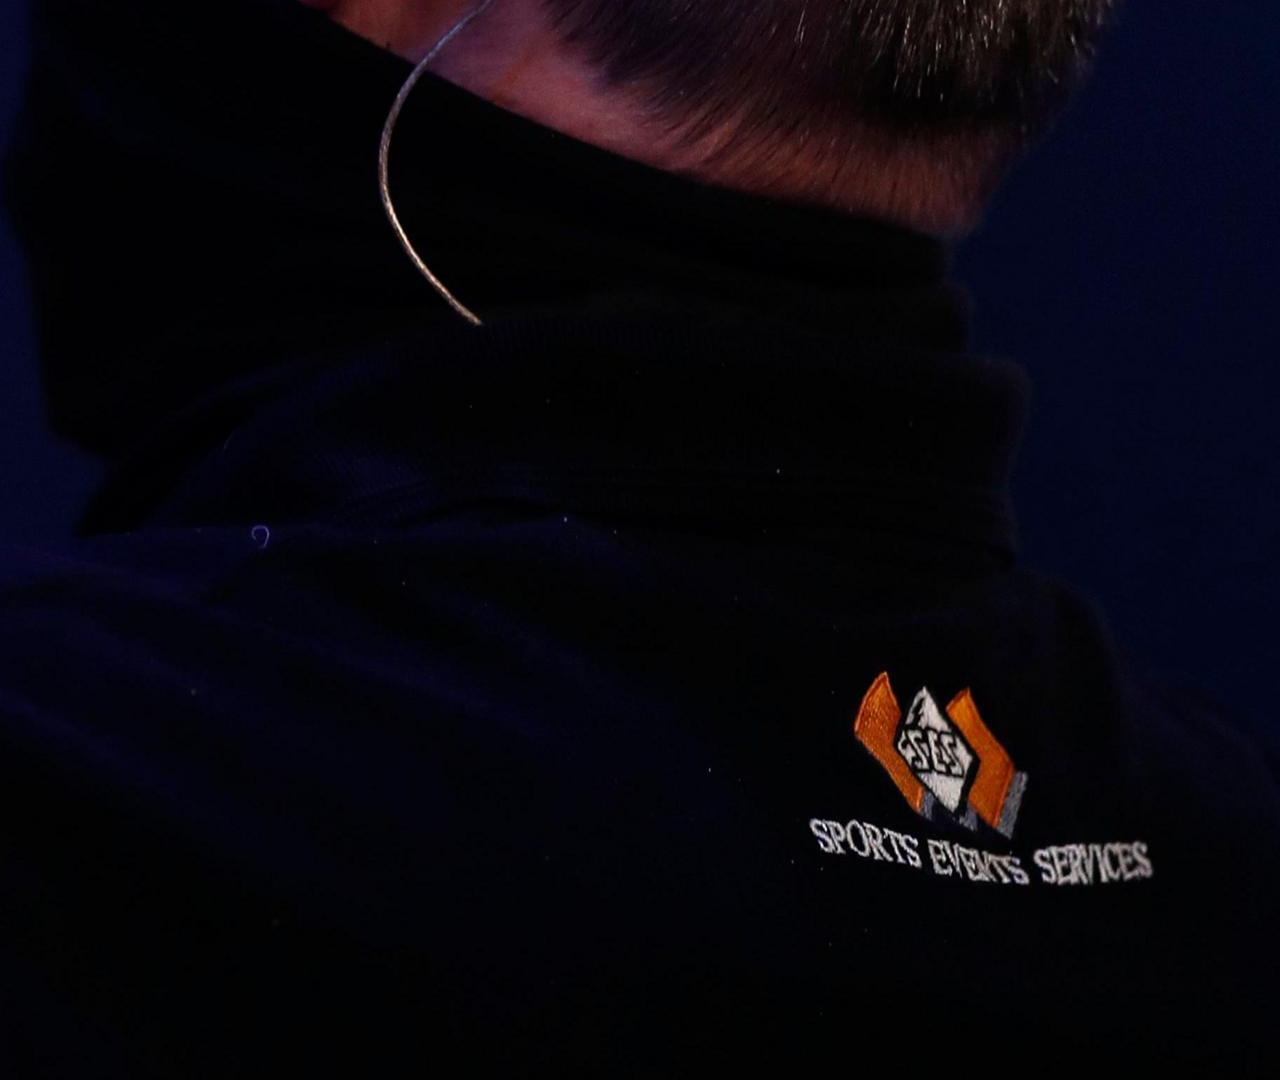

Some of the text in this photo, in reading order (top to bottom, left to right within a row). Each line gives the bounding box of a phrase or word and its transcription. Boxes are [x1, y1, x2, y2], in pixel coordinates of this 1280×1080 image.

[901, 725, 965, 779] SES
[809, 818, 1153, 886] SPORTS EVENTS SERVICES
